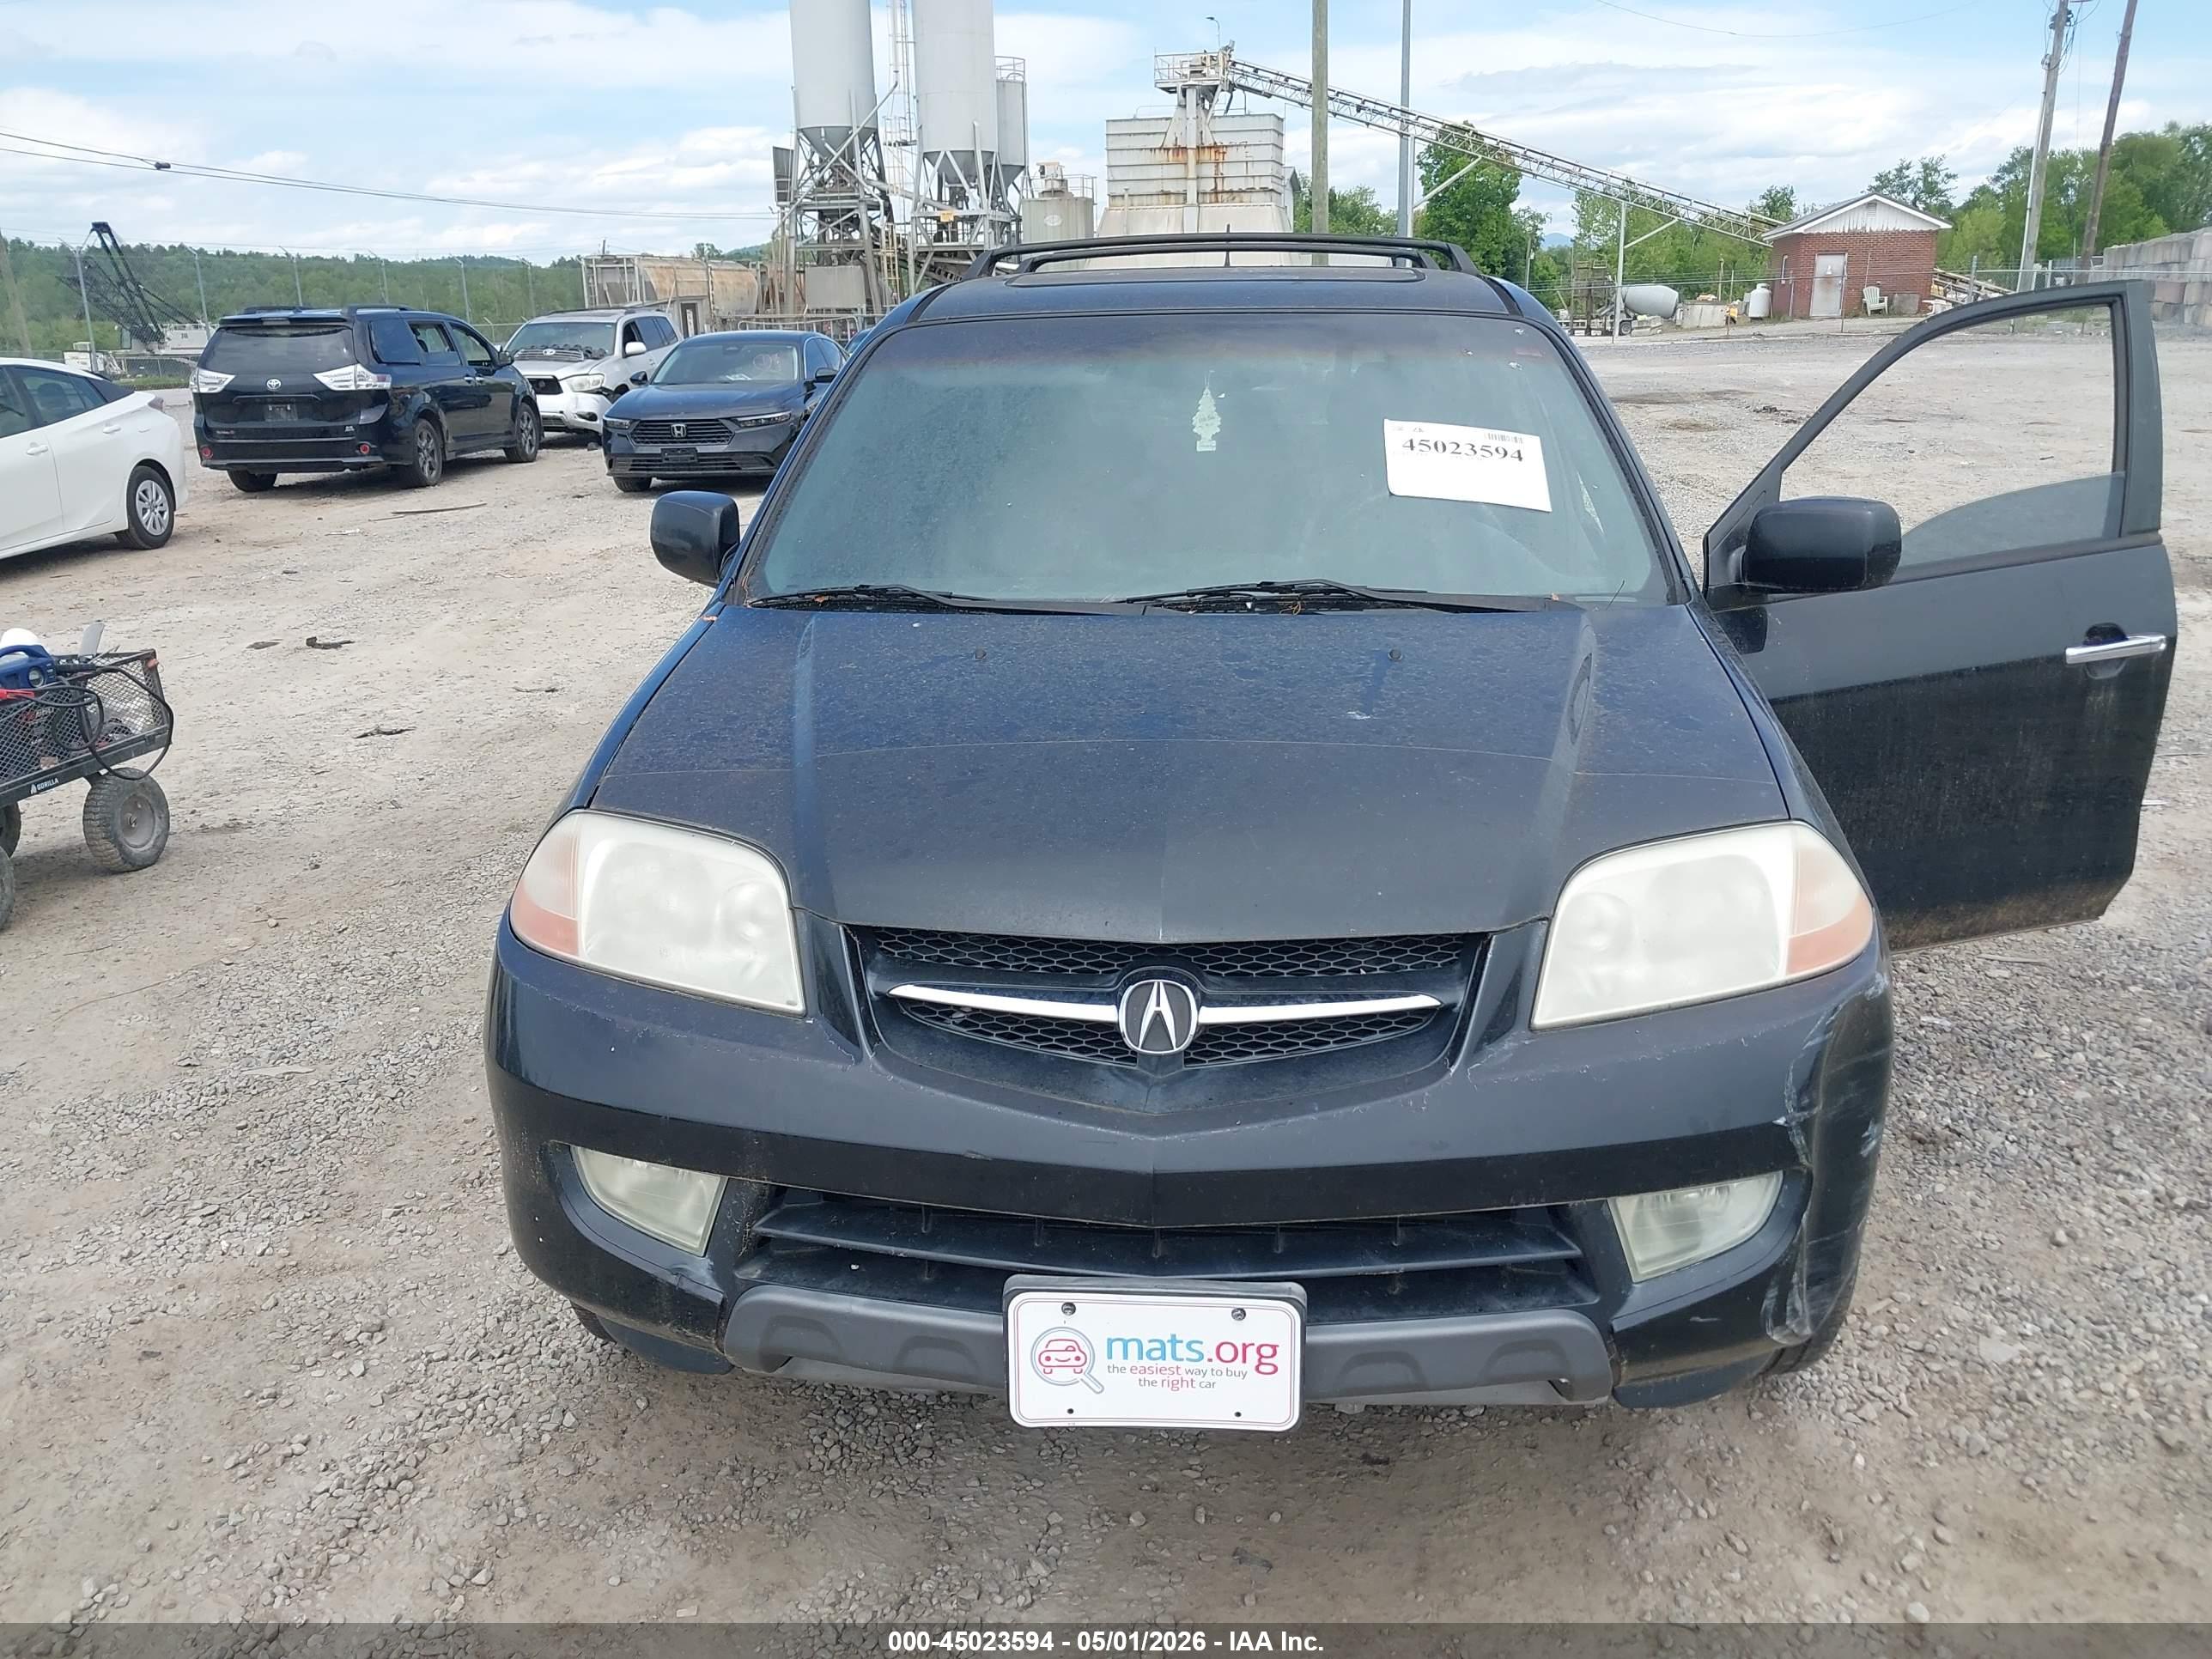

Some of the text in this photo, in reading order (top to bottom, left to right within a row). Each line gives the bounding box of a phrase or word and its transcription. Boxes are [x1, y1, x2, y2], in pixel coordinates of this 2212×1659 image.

[1401, 438, 1523, 462] 45023594
[36, 777, 59, 790] GORILLA
[1106, 1333, 1279, 1376] mats.org
[1107, 1364, 1248, 1380] the easiest way to buy
[1139, 1376, 1216, 1392] the right car
